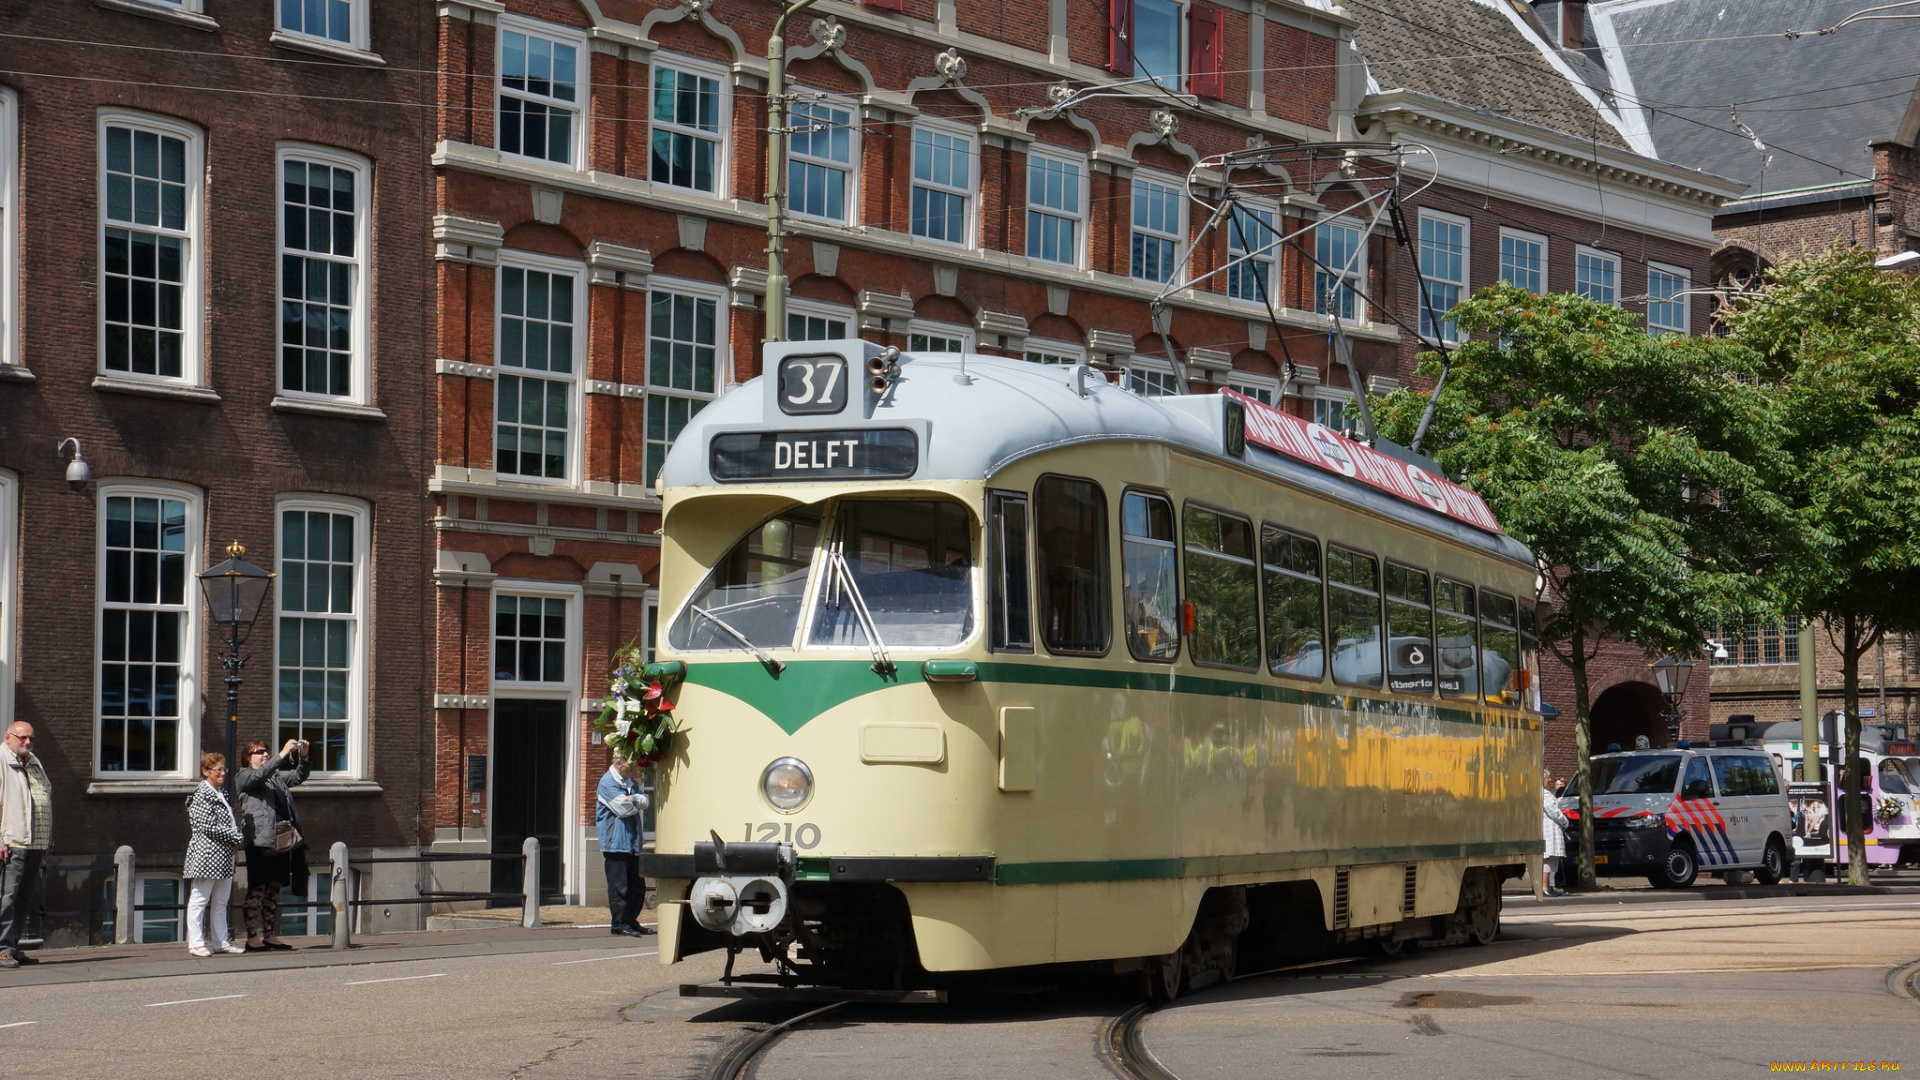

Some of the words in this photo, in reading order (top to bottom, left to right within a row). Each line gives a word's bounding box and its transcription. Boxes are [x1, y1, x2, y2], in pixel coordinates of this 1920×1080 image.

[787, 360, 842, 404] 37
[775, 440, 859, 469] DELFT
[1228, 393, 1321, 462] MARTINI
[1342, 440, 1419, 501] MARTINI
[1433, 477, 1498, 530] MARTINI
[744, 822, 822, 850] 1210
